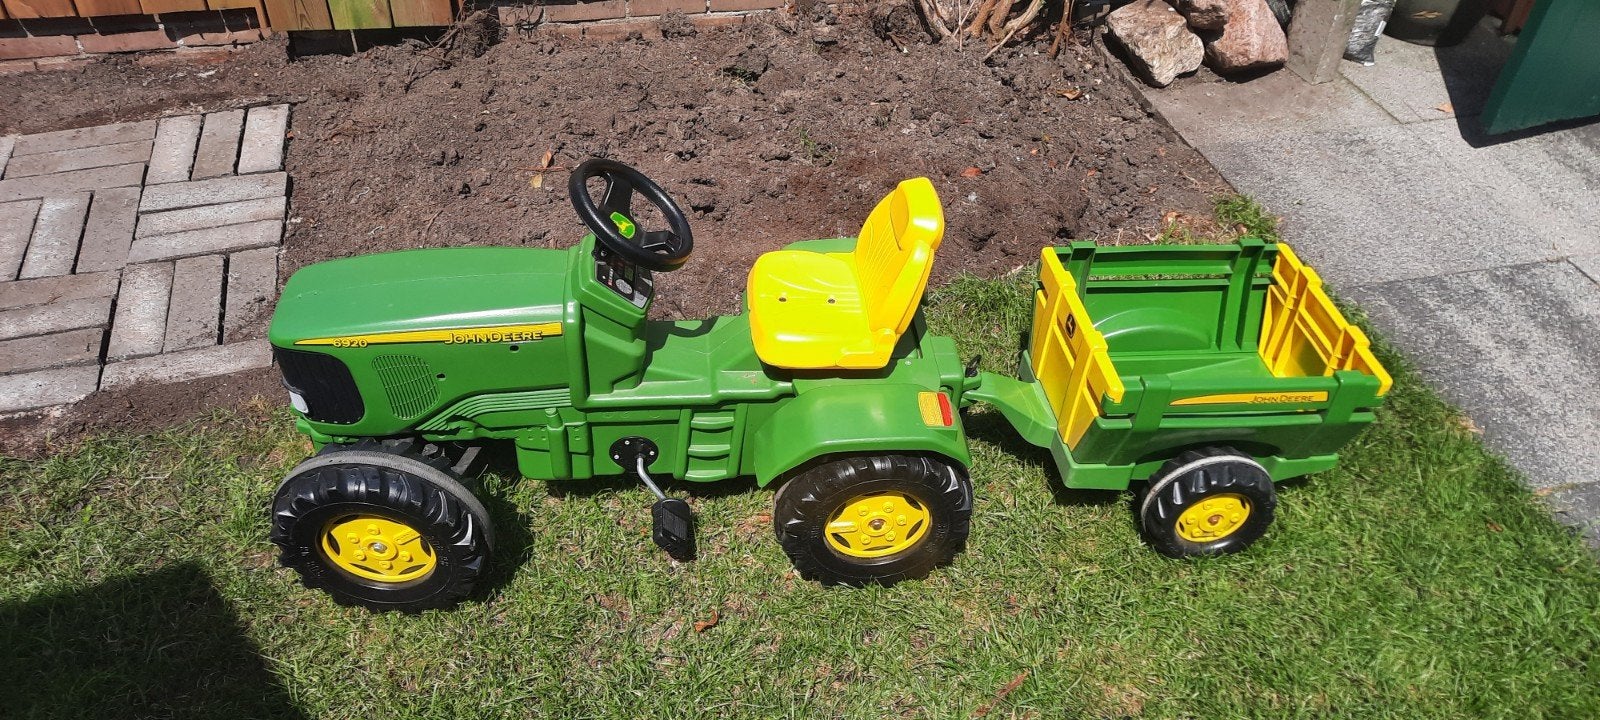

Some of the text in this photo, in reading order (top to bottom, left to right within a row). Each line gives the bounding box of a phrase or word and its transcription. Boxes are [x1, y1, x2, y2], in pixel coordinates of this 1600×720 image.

[444, 330, 543, 344] JOHN DEERE
[332, 338, 368, 348] 6920
[1251, 394, 1314, 404] JOHN DEERE
